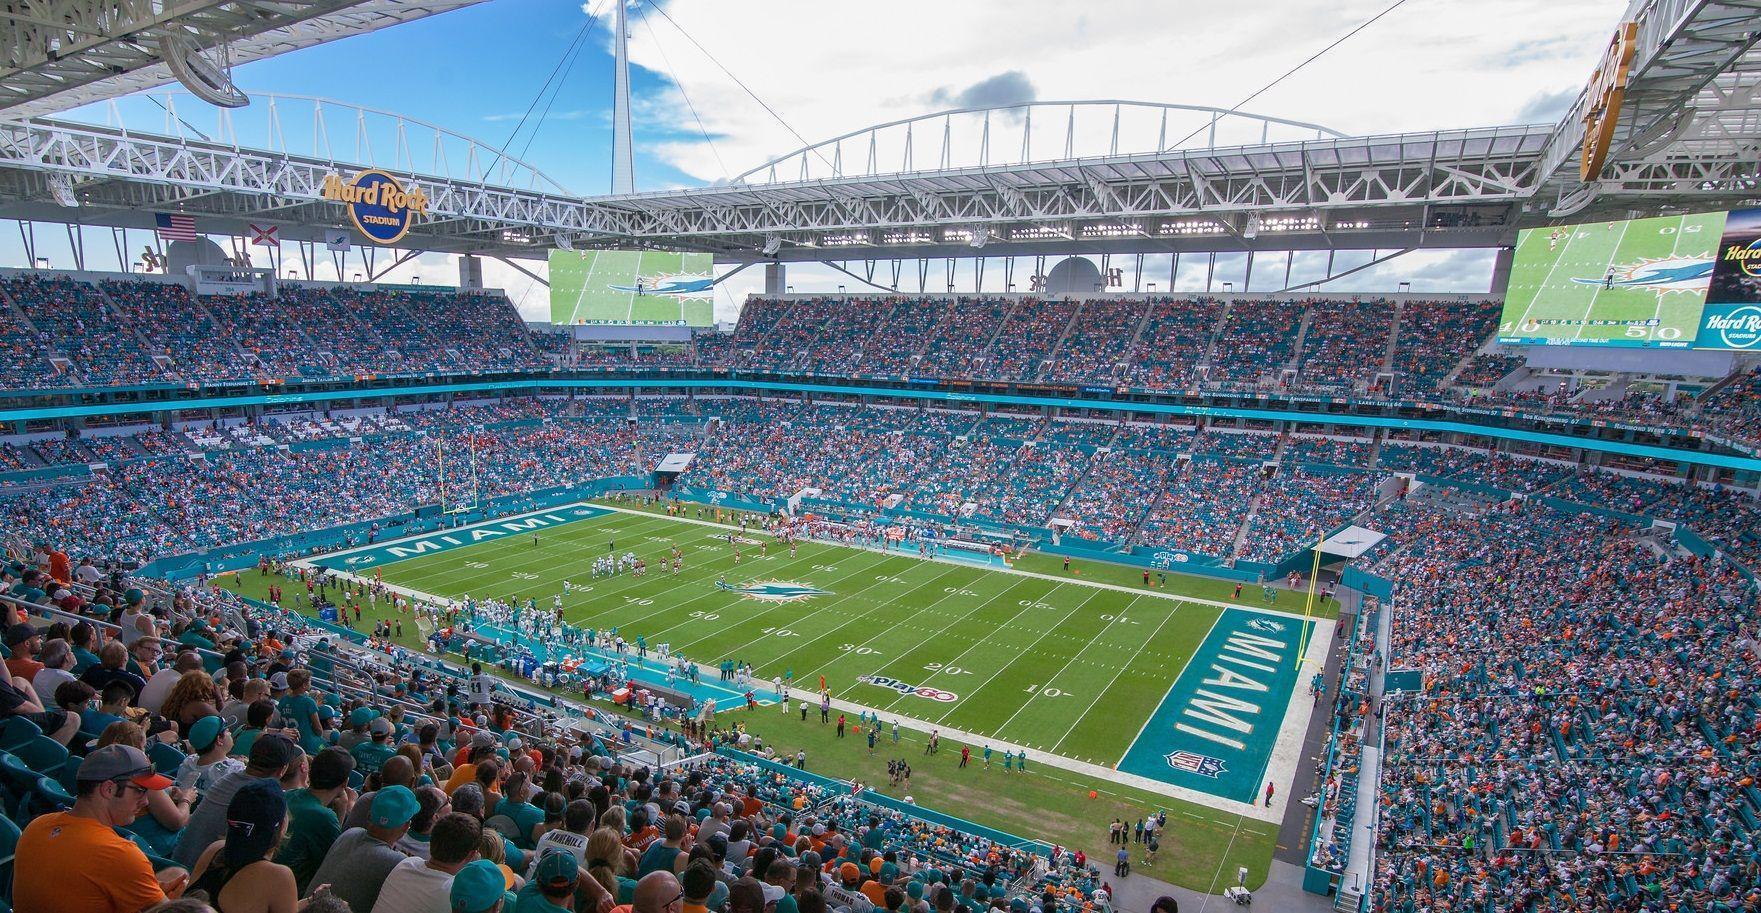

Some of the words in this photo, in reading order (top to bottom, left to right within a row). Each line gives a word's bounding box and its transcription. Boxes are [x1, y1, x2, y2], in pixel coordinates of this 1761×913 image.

[324, 175, 378, 205] Hard
[380, 182, 428, 216] Rock
[363, 215, 400, 226] STADIUM
[1705, 315, 1747, 329] Hard
[386, 514, 566, 557] MIAMI
[922, 662, 962, 675] 20
[1023, 684, 1061, 698] 10
[1174, 631, 1287, 751] MIAMI
[831, 890, 854, 905] THOMAS
